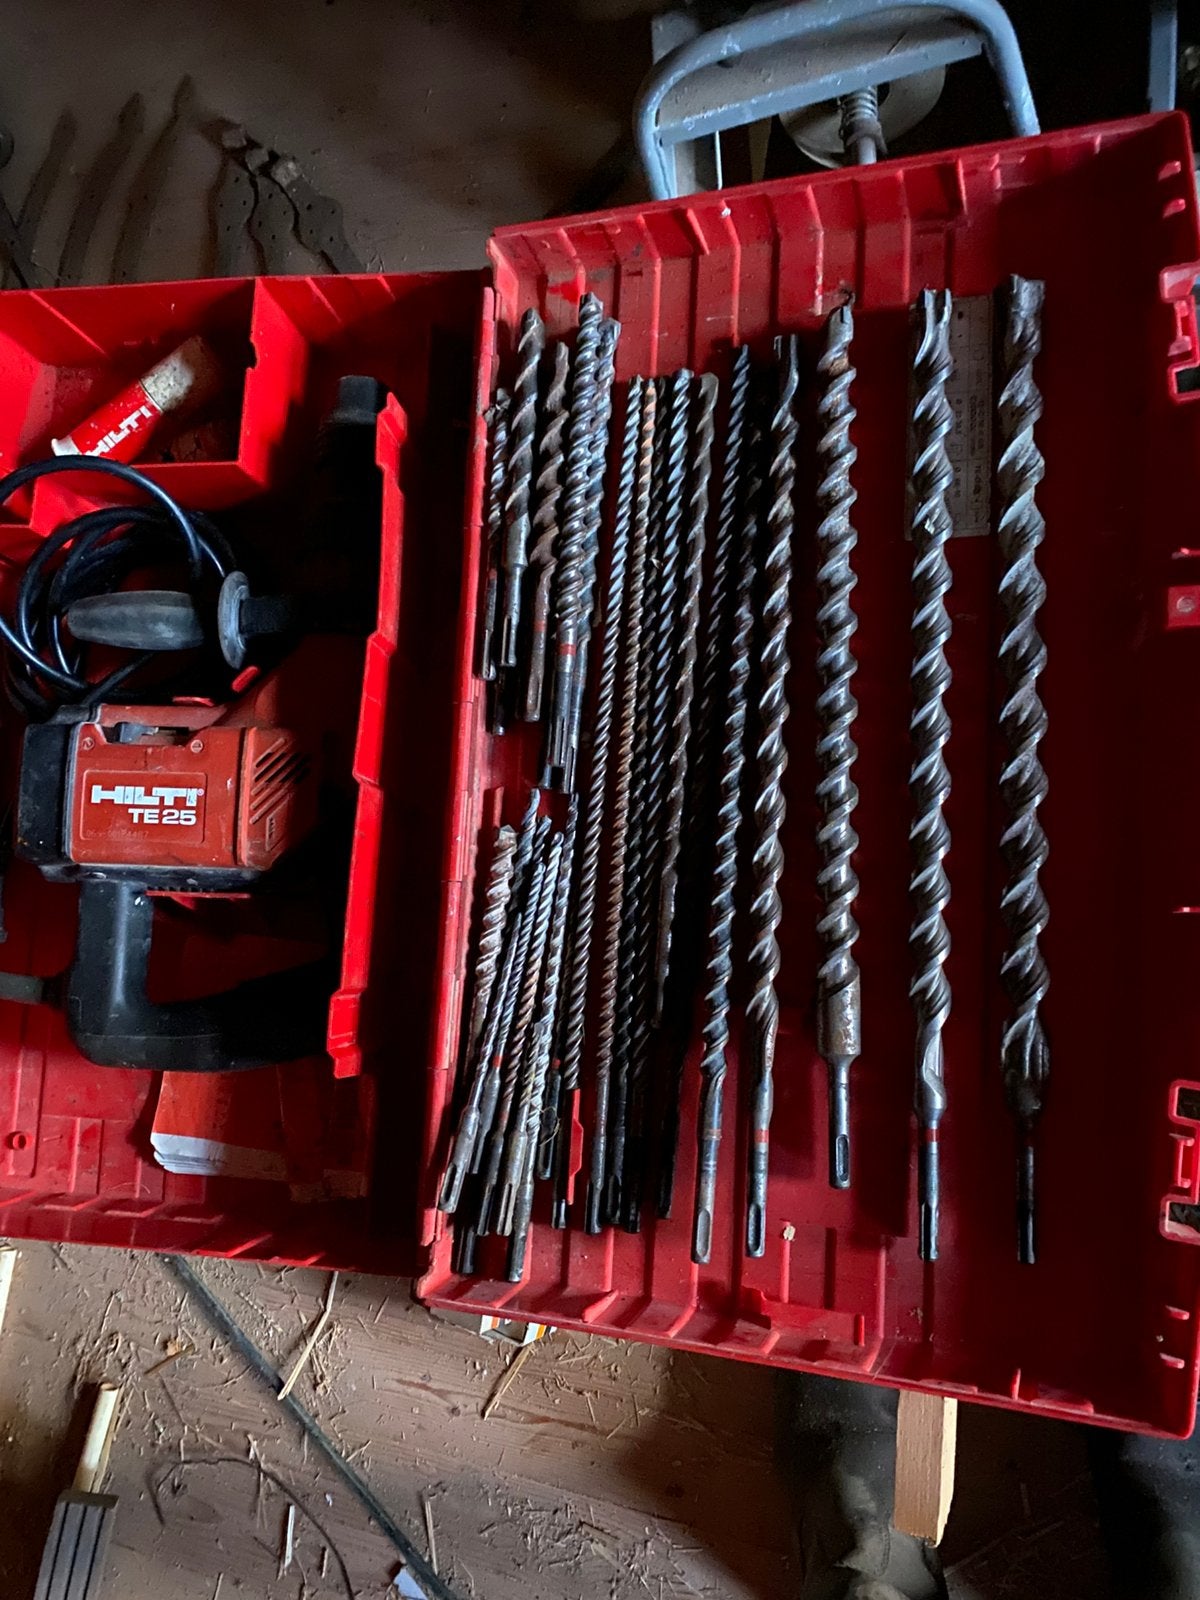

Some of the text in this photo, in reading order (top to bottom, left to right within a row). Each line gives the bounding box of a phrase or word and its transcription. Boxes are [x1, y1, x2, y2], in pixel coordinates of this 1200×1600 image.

[84, 405, 153, 457] HILTI
[91, 785, 198, 807] HILTI
[128, 808, 197, 825] TE 25
